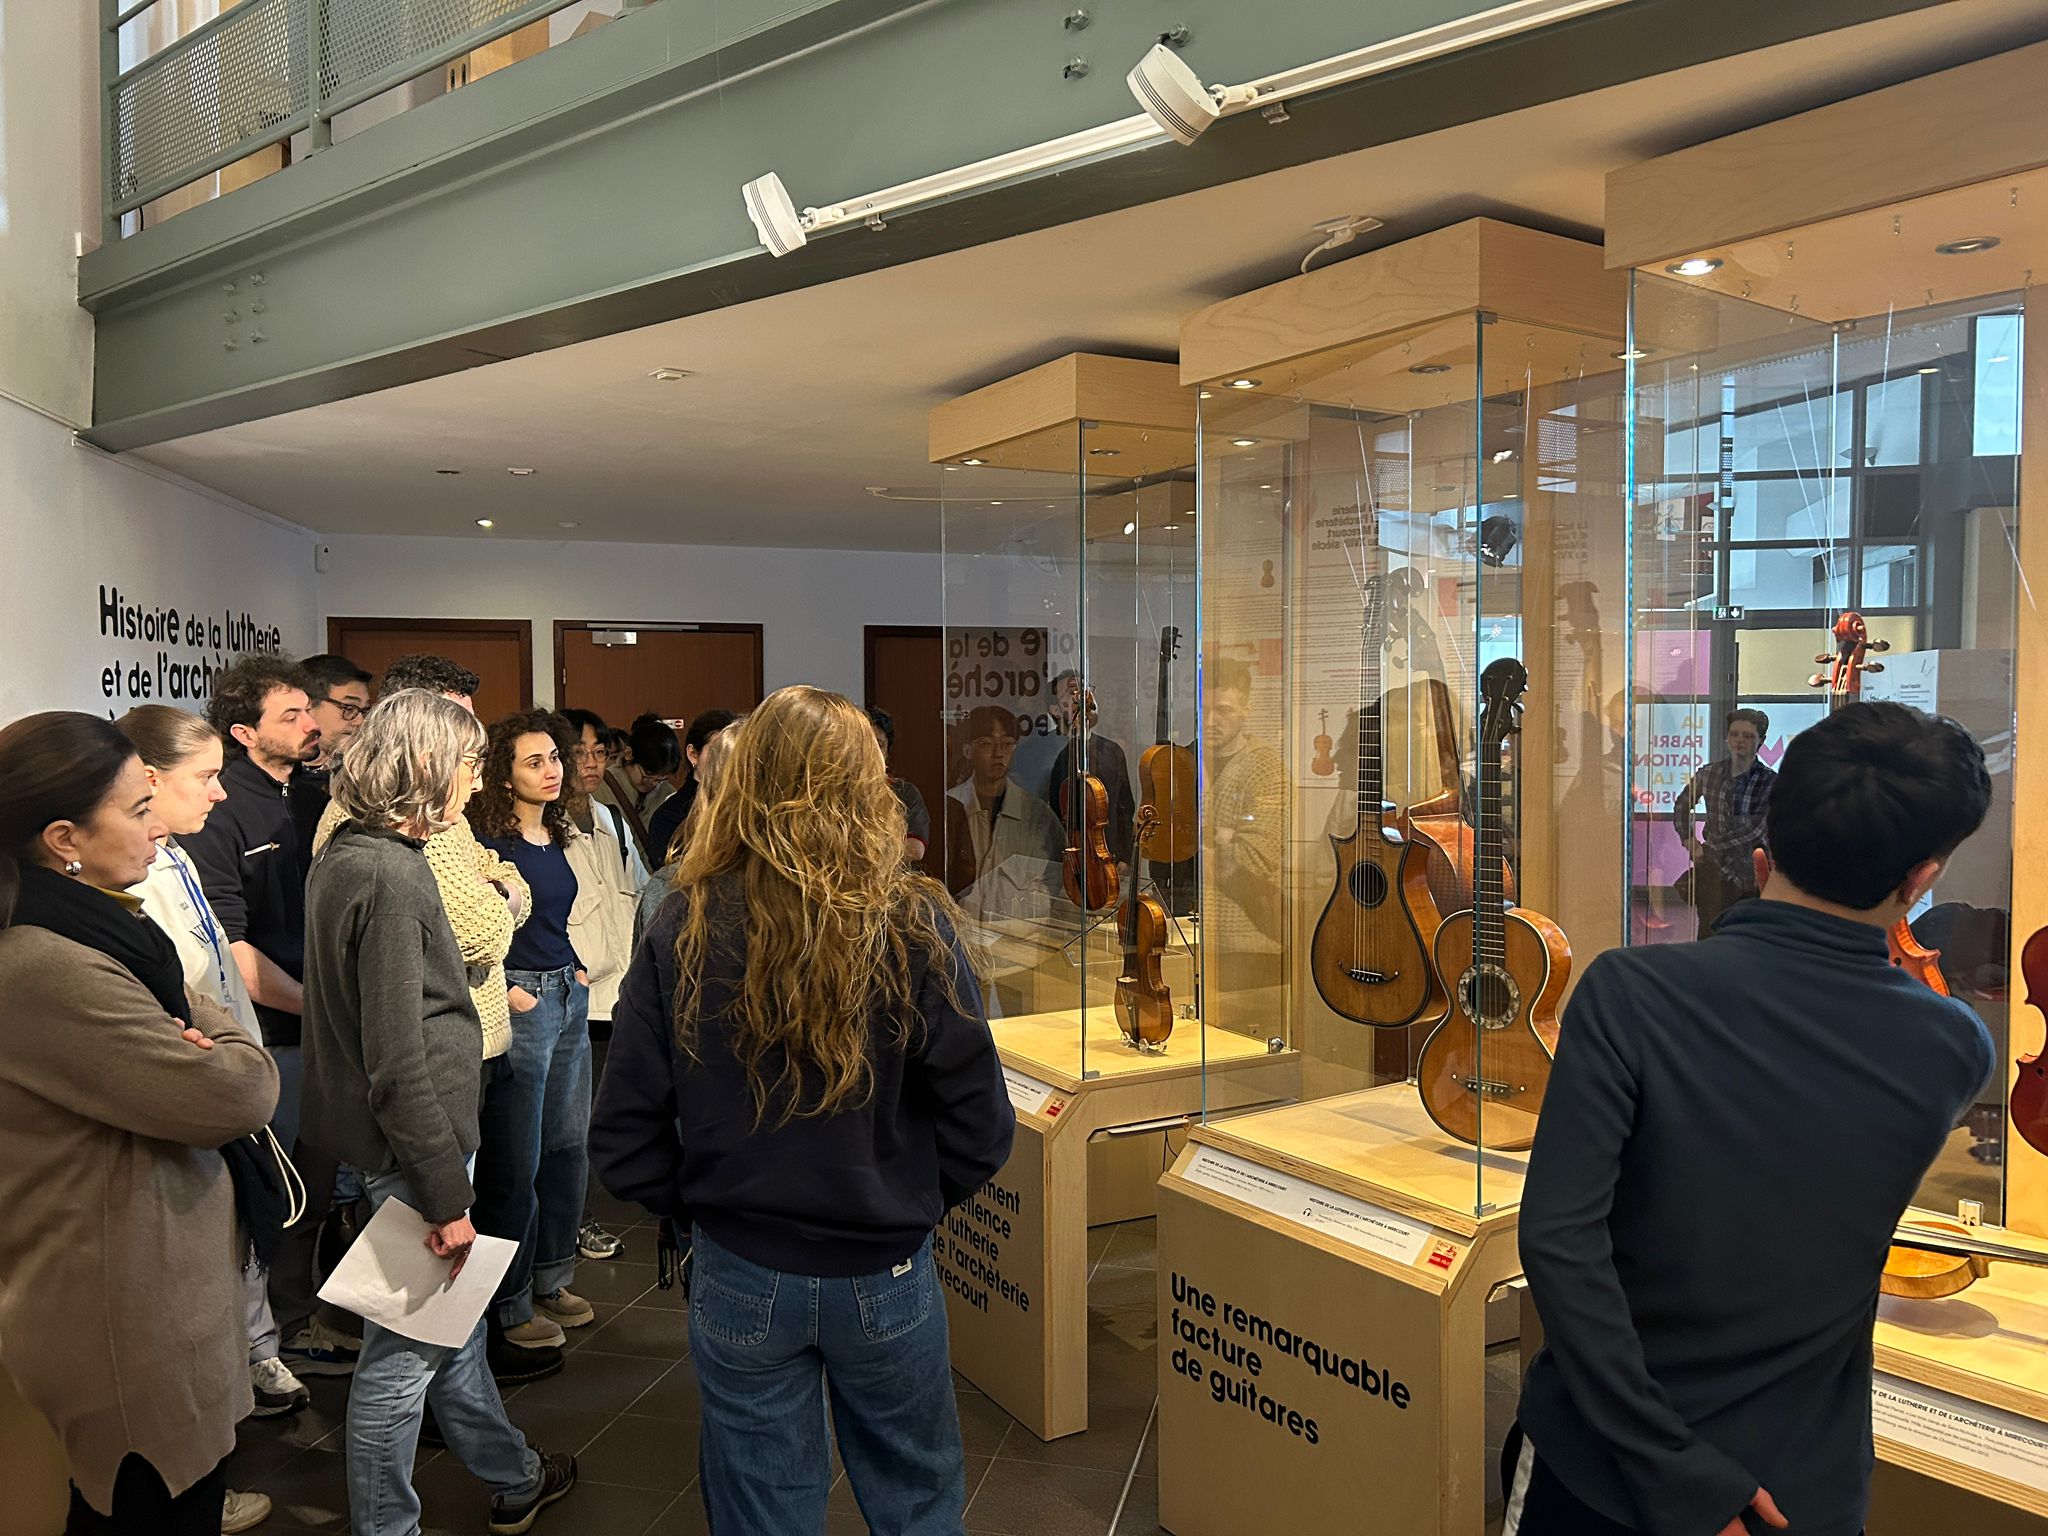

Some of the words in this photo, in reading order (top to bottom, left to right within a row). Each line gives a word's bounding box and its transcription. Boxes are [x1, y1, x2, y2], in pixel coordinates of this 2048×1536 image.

[100, 584, 180, 646] Histoire
[185, 613, 204, 648] de
[208, 616, 221, 650] la
[225, 608, 281, 655] lutherie
[101, 659, 122, 697] et
[127, 660, 152, 698] de
[960, 1196, 1011, 1239] ellence
[982, 1181, 1020, 1215] ment
[947, 1209, 999, 1262] lutherie
[933, 1255, 988, 1314] irecourt
[948, 1238, 1029, 1312] l'archèterie
[1171, 1271, 1217, 1317] Une
[1223, 1302, 1411, 1410] remarquable
[1171, 1308, 1262, 1376] facture
[1171, 1347, 1203, 1382] de
[1209, 1369, 1319, 1445] guitares
[1898, 1397, 1928, 1411] LUTHERIE
[1948, 1413, 1996, 1433] L'ARCHÈTERIE
[1996, 1427, 2003, 1435] À
